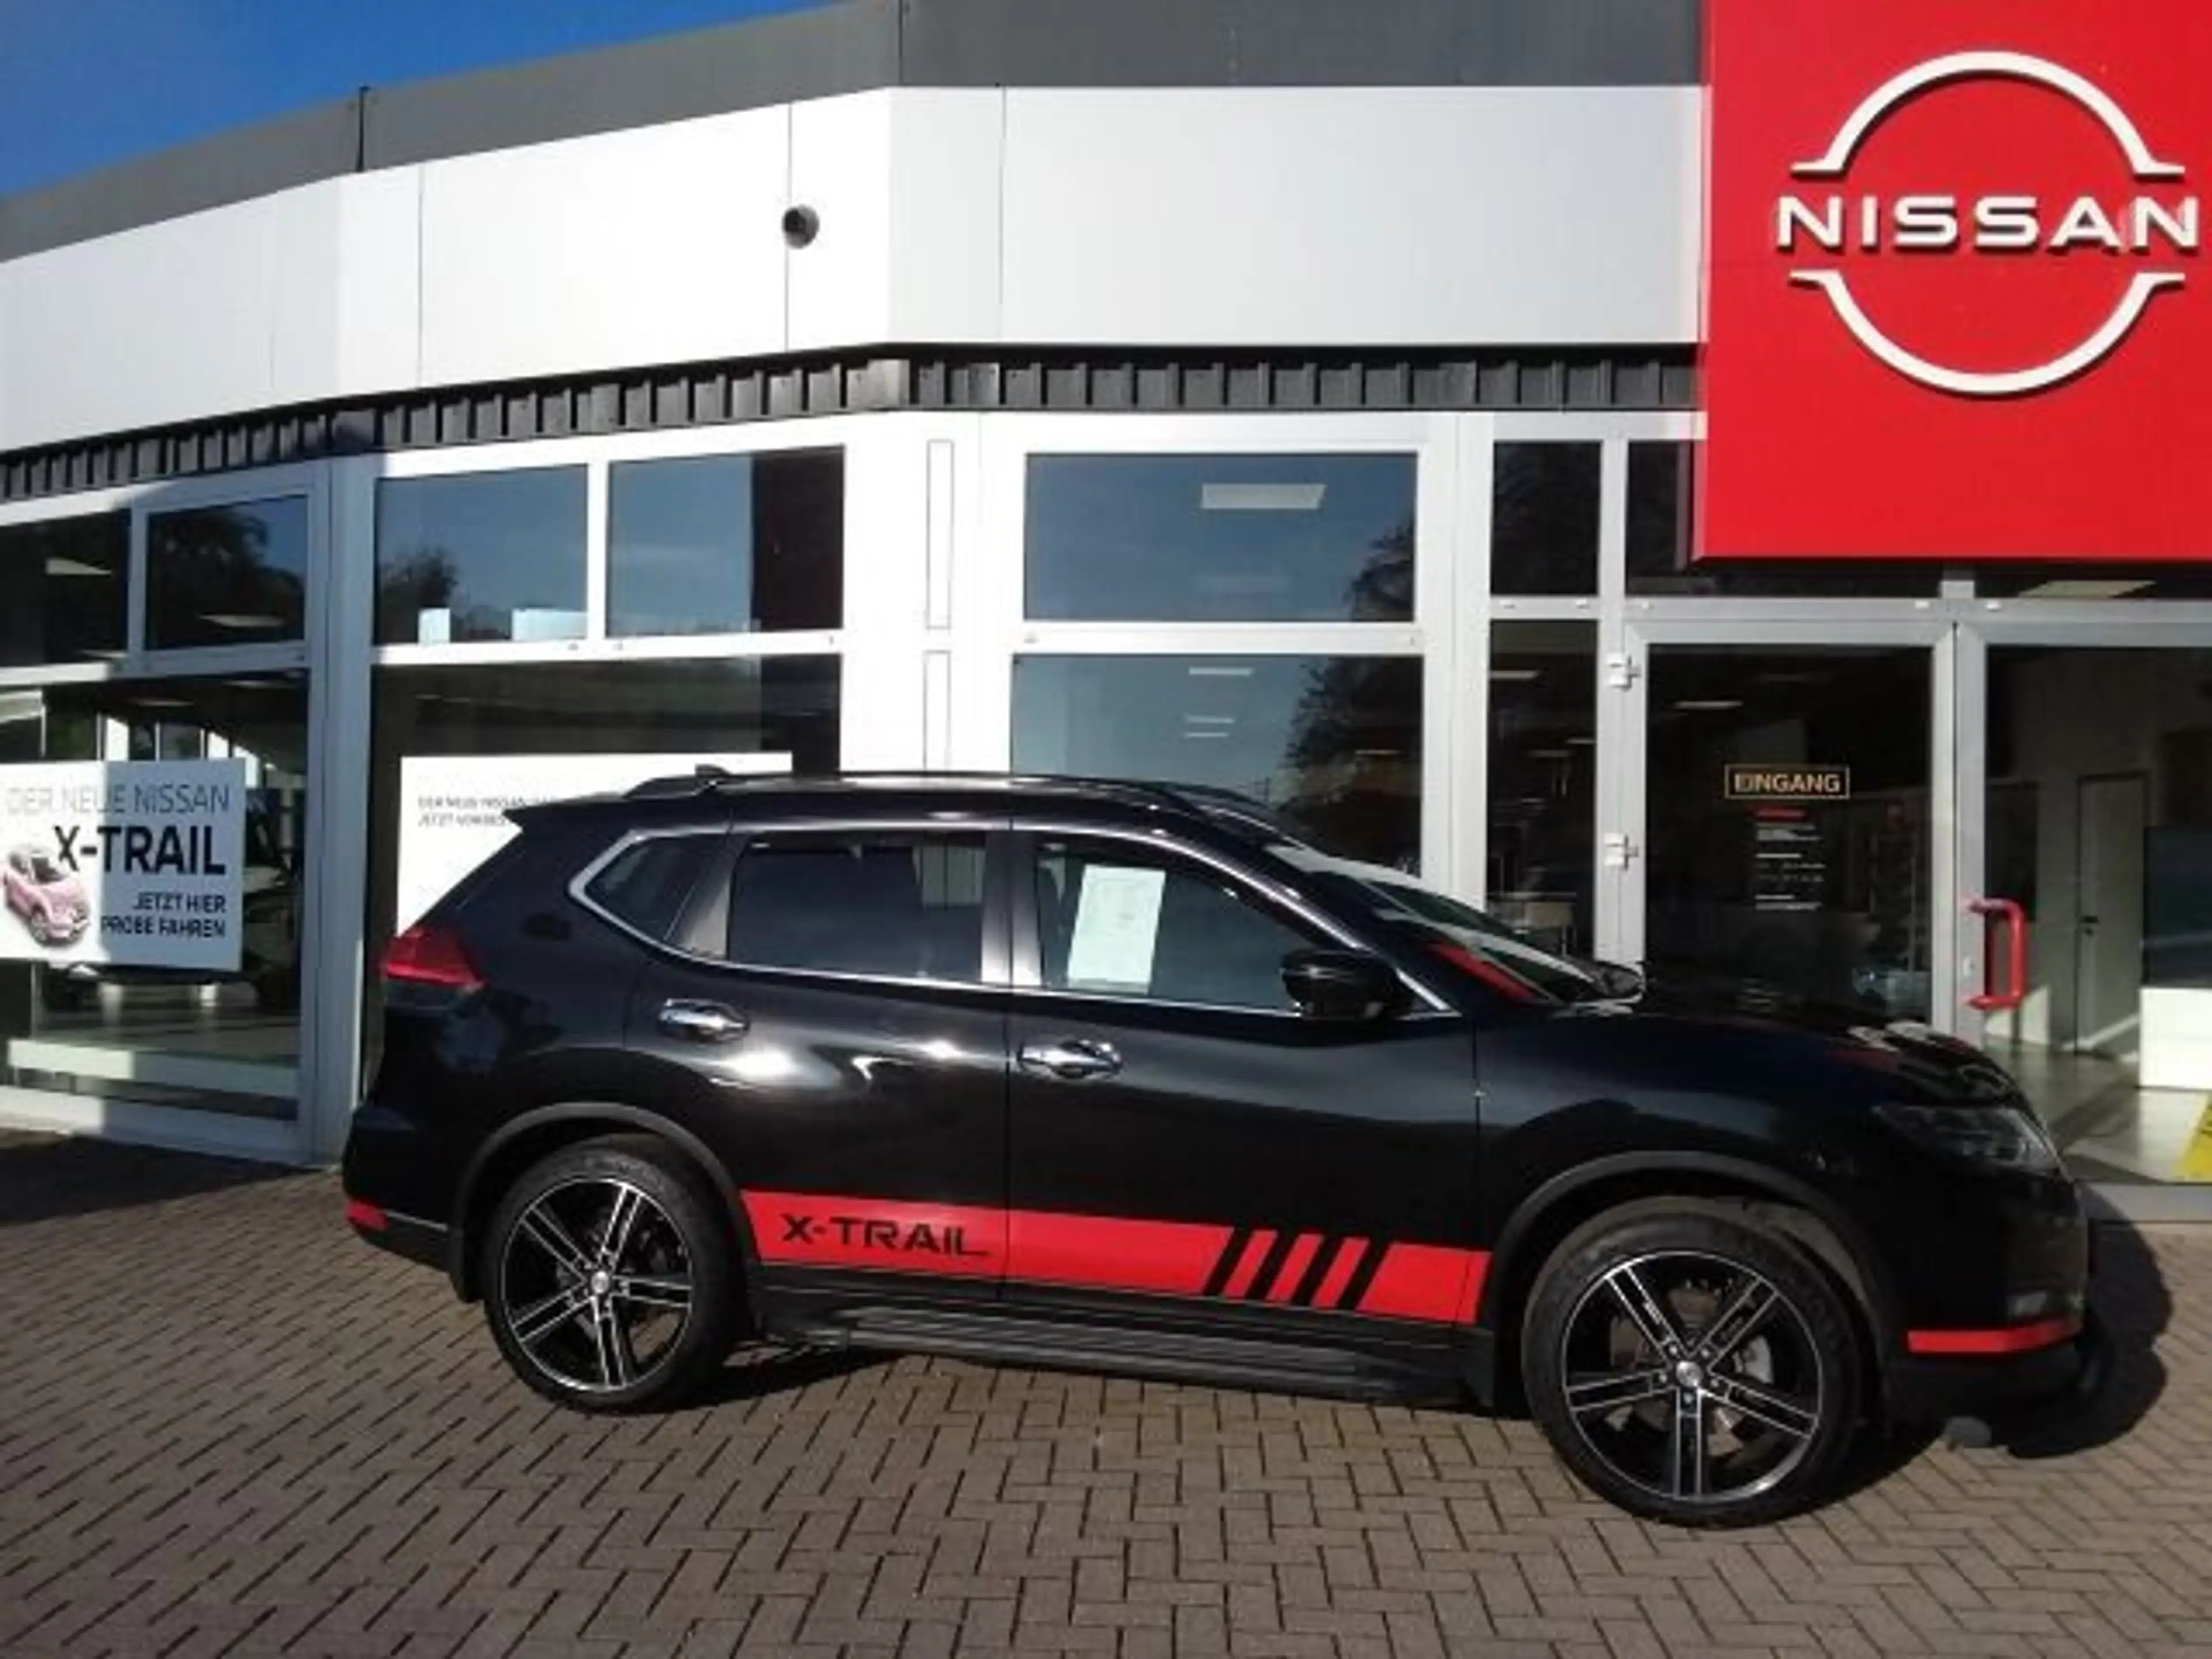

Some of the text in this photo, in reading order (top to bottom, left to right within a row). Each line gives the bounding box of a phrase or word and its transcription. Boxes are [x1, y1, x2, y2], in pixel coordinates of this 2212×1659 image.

[1777, 196, 2199, 248] NISSAN
[1734, 773, 1841, 793] EINGANG
[7, 784, 229, 815] DER NEUE NISSAN
[54, 825, 226, 875] X-TRAIL
[132, 892, 227, 914] JETZT HIER
[100, 915, 226, 940] PROBE FAHREN
[780, 1213, 990, 1256] X-TRAIL
